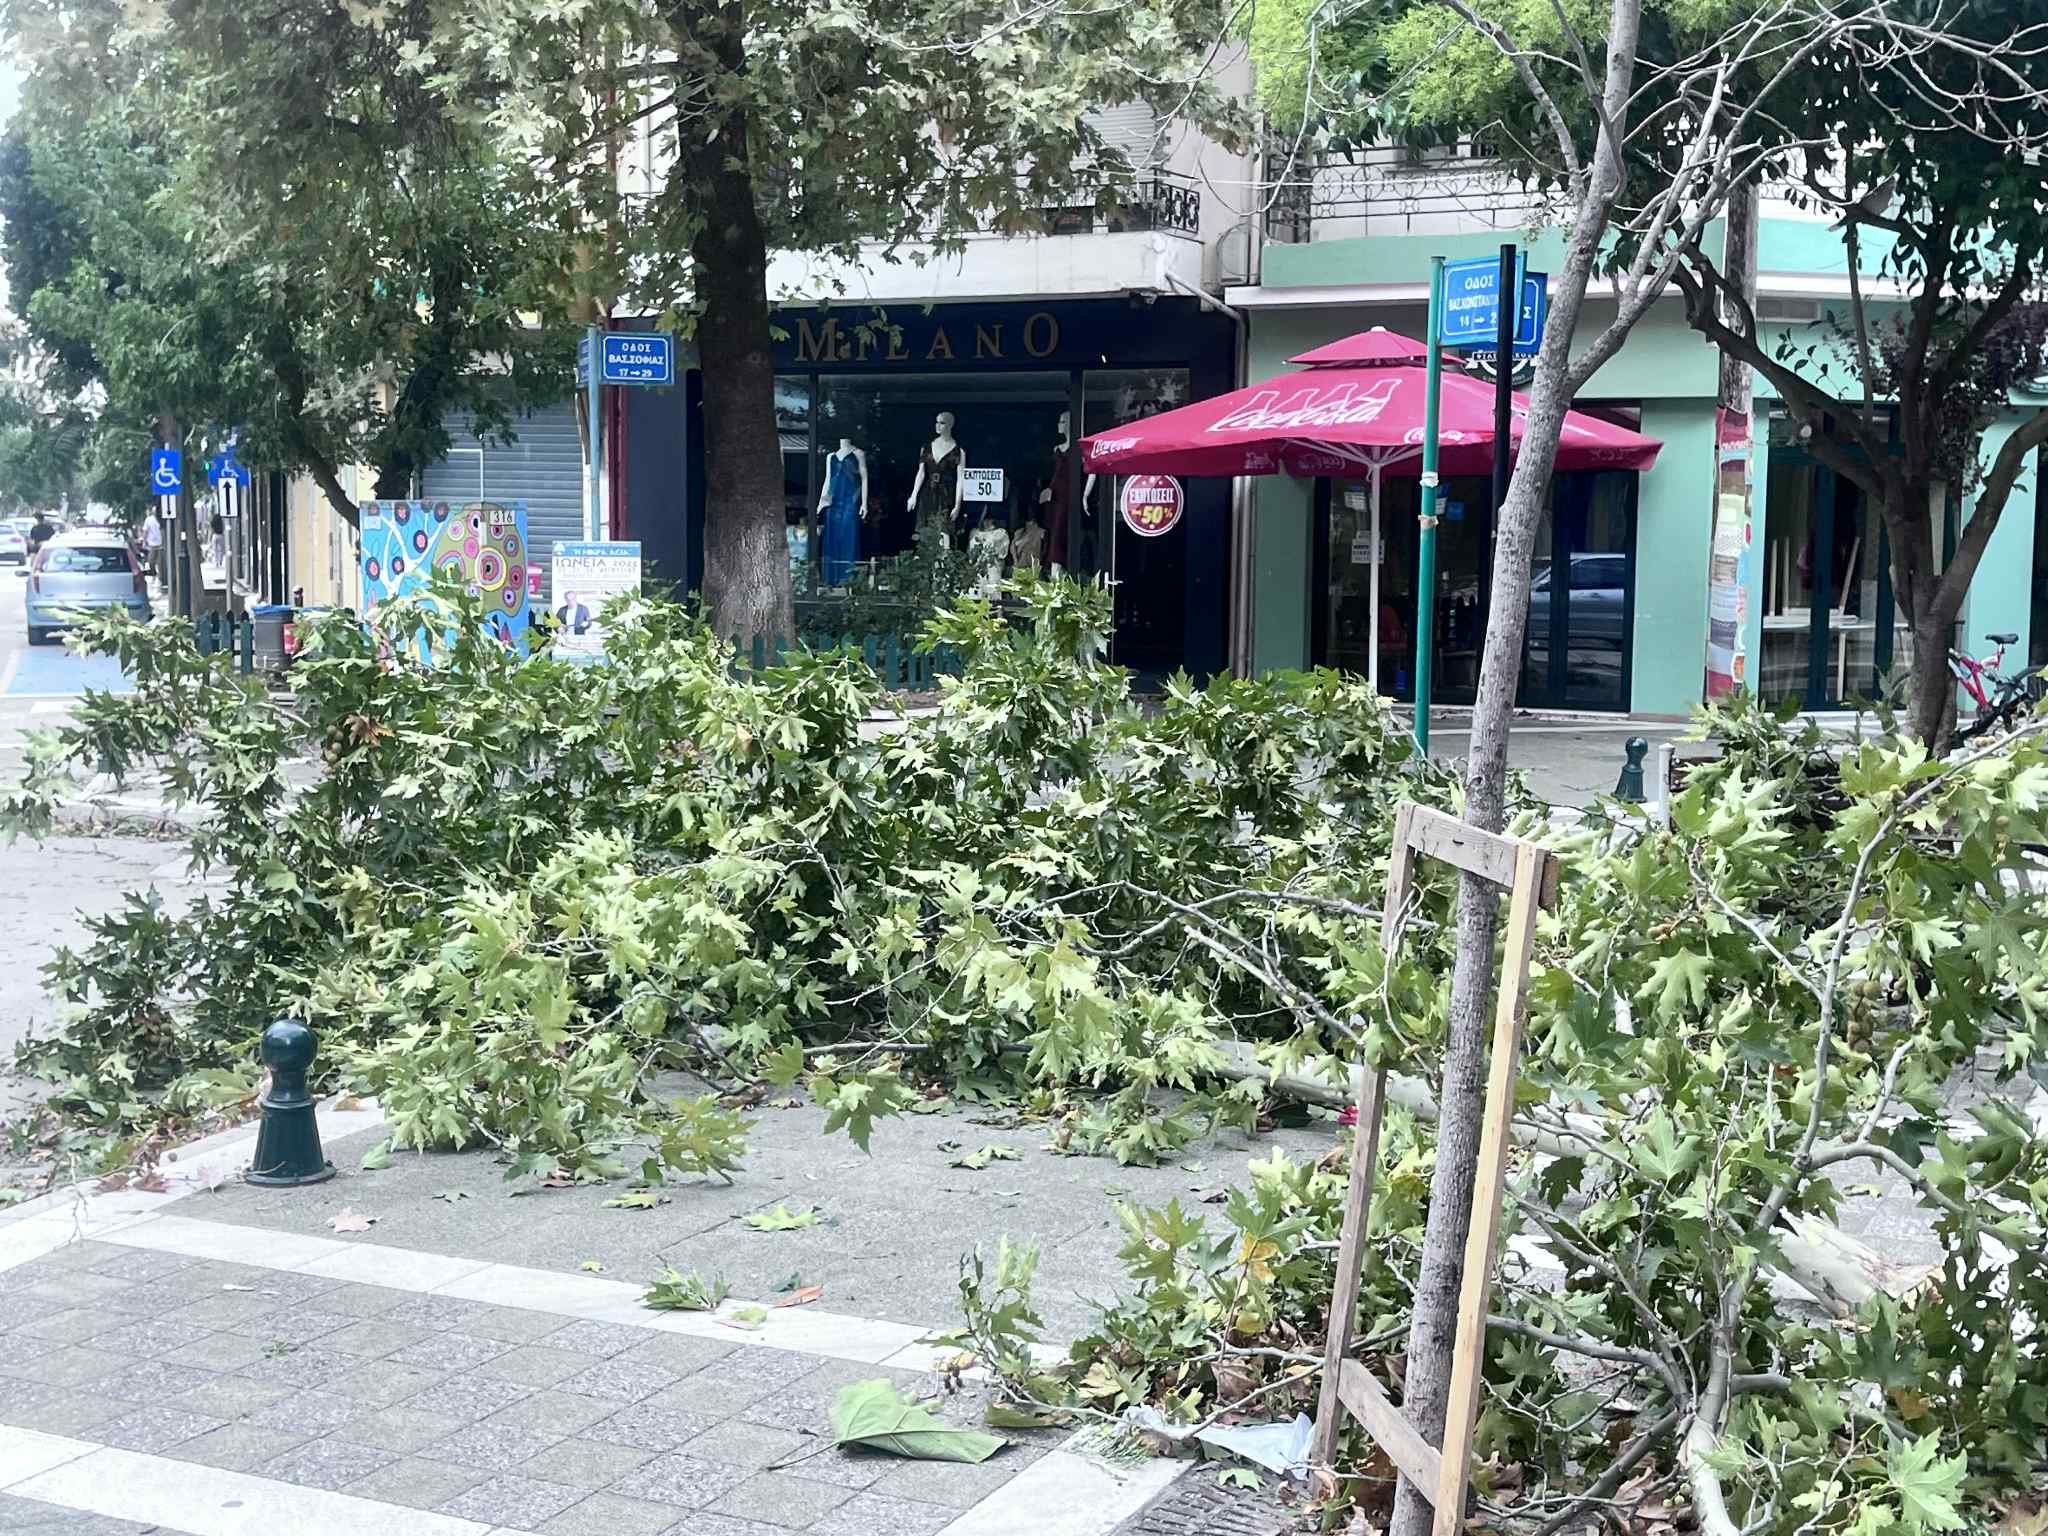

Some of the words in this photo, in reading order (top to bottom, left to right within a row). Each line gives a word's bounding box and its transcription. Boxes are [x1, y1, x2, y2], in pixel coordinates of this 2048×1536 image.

[1465, 275, 1494, 290] ΟΔΟΣ
[622, 343, 651, 352] ΟΔΟΣ
[619, 368, 628, 376] 17
[977, 482, 992, 496] 50
[1129, 488, 1175, 504] ΕΚΠΤΩΣΕΙΣ
[494, 511, 513, 523] 316
